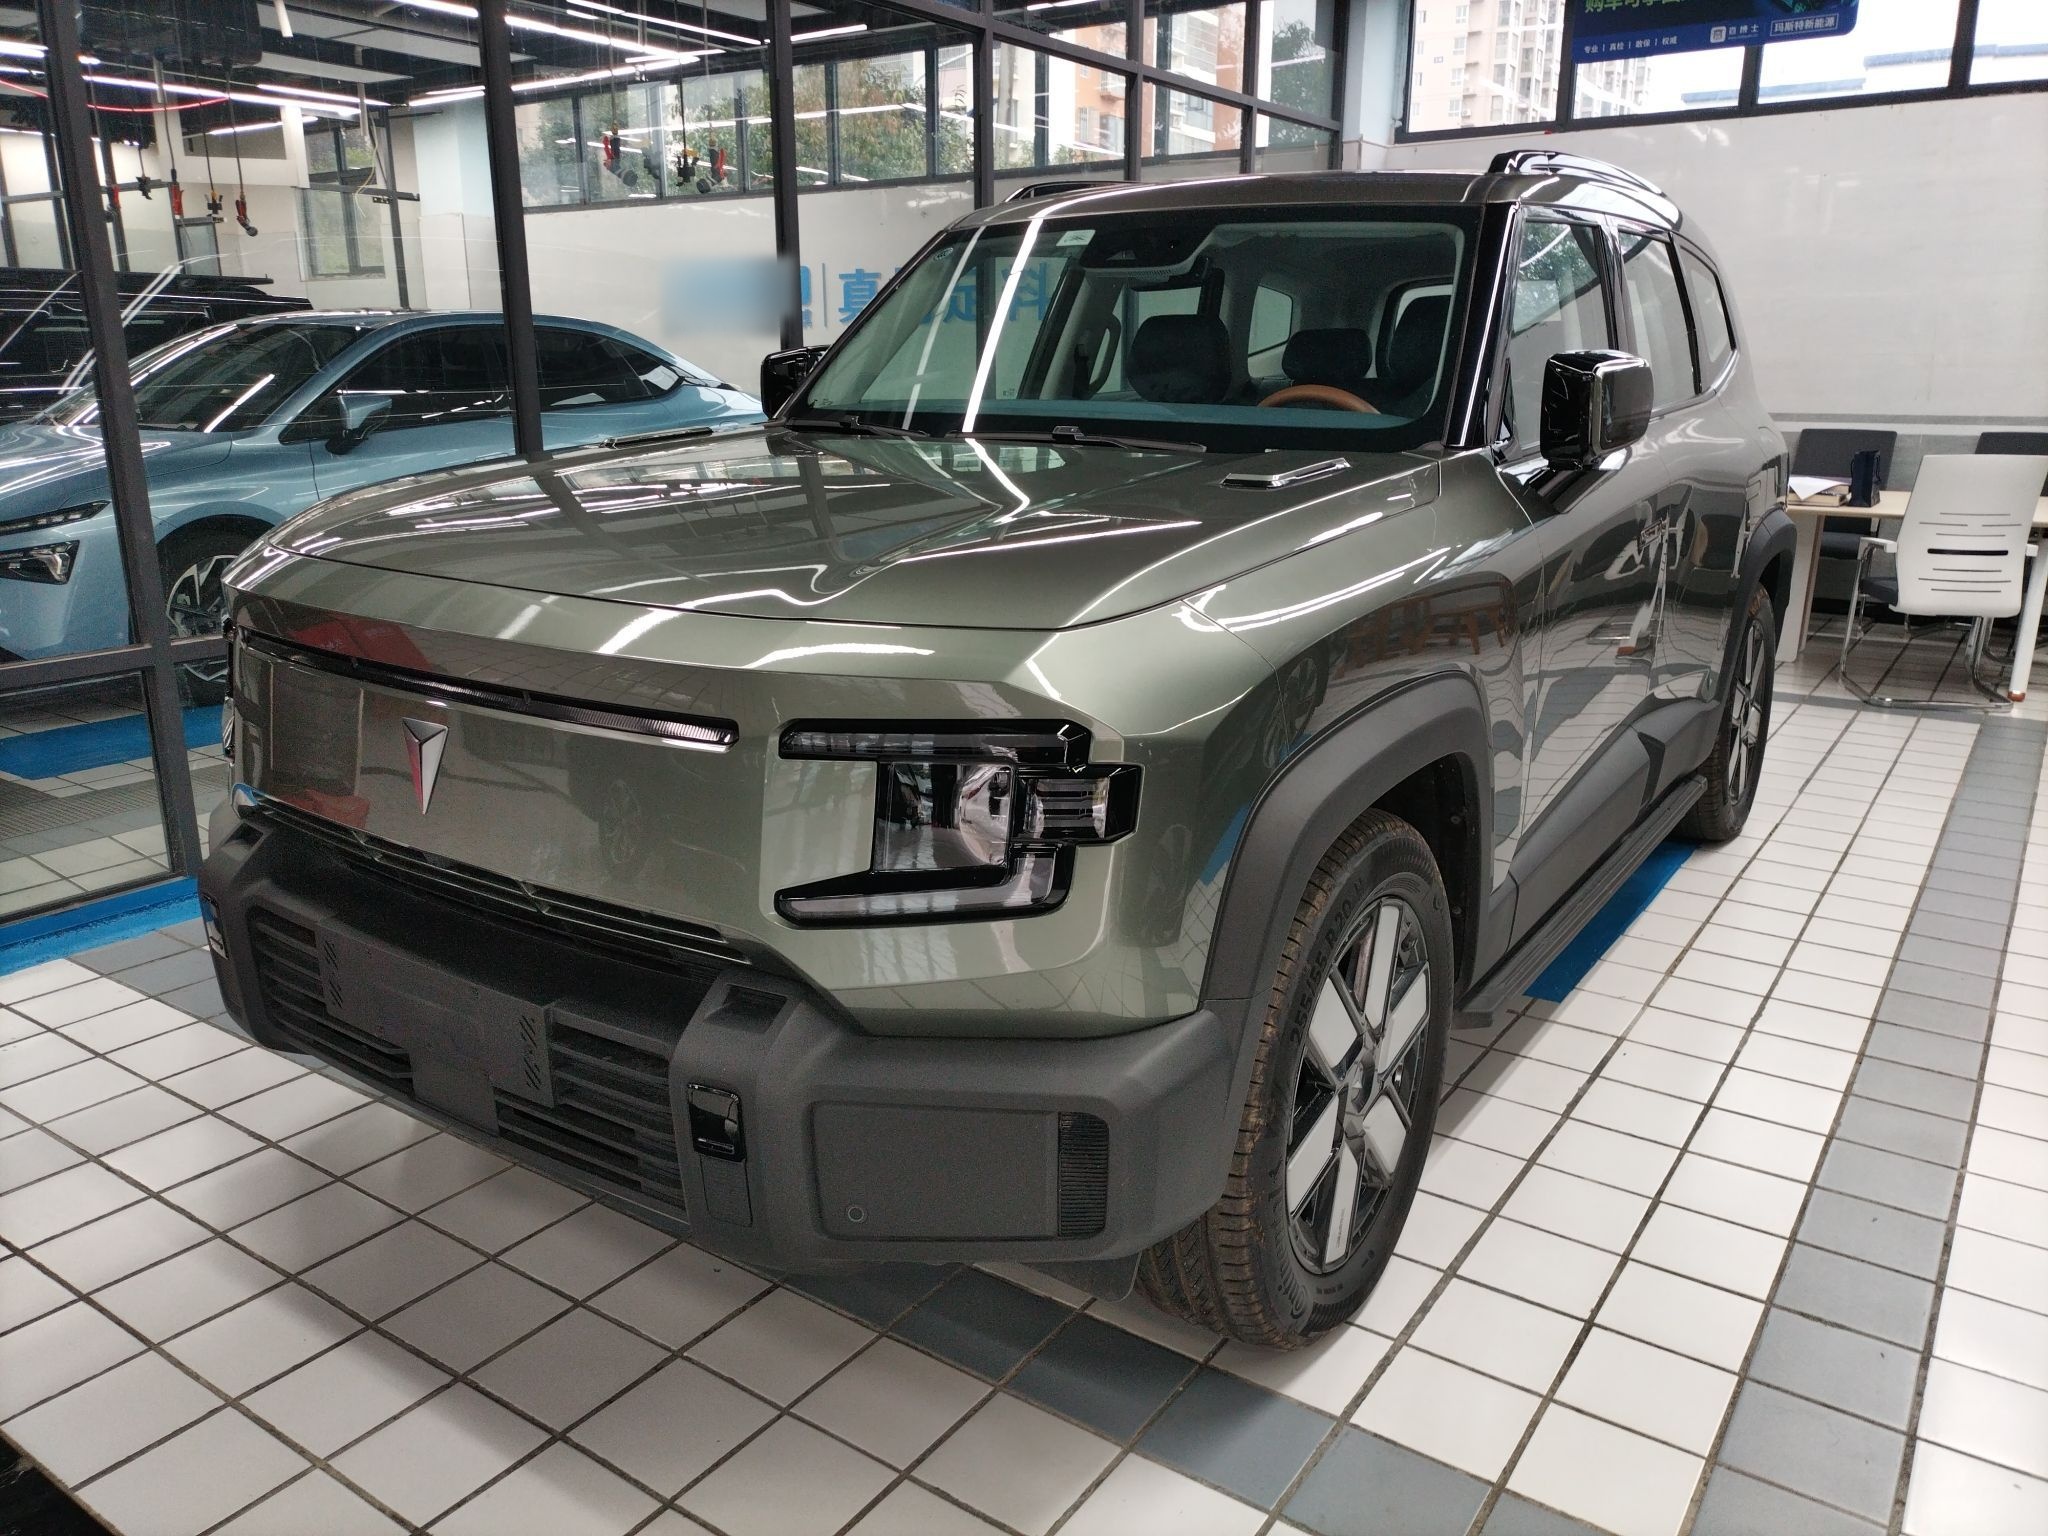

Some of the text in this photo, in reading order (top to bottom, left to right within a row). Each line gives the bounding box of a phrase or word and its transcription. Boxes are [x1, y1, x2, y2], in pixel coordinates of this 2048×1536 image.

[1774, 17, 1835, 33] 玛斯特新能源
